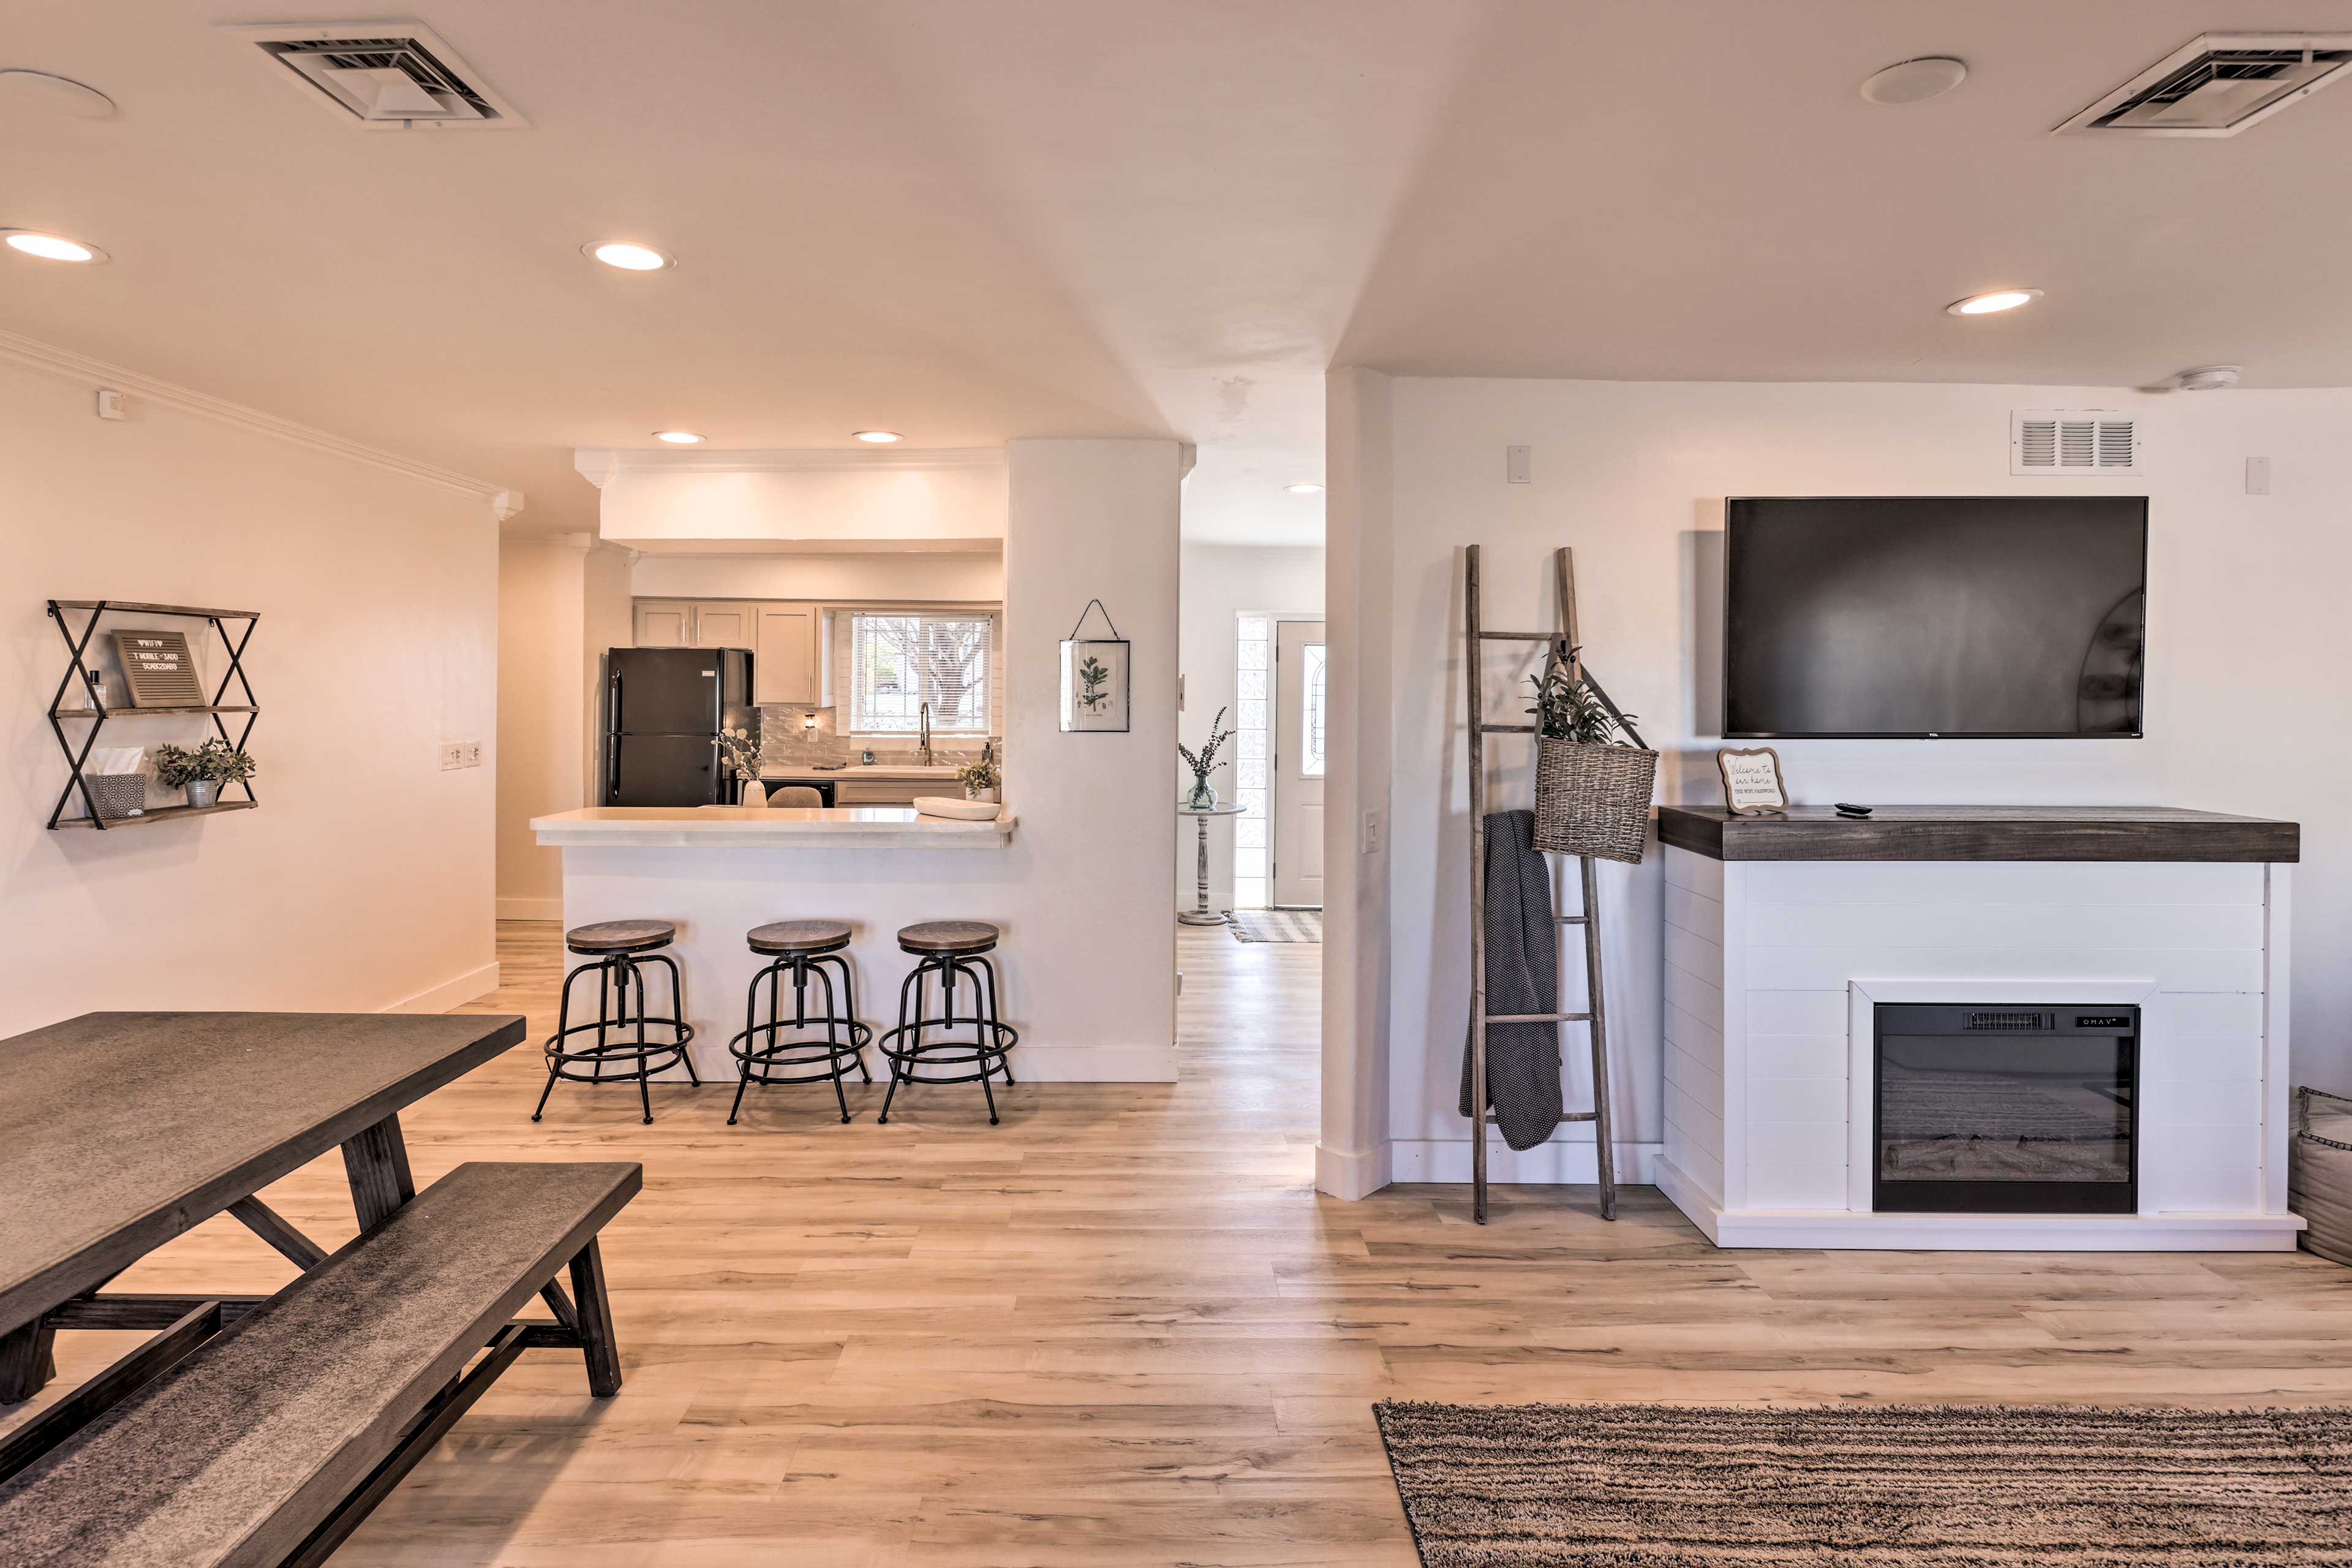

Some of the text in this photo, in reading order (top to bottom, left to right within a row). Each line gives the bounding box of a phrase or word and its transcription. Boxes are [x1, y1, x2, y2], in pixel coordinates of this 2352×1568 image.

[1727, 758, 1771, 775] Welcome to
[1750, 774, 1771, 784] home
